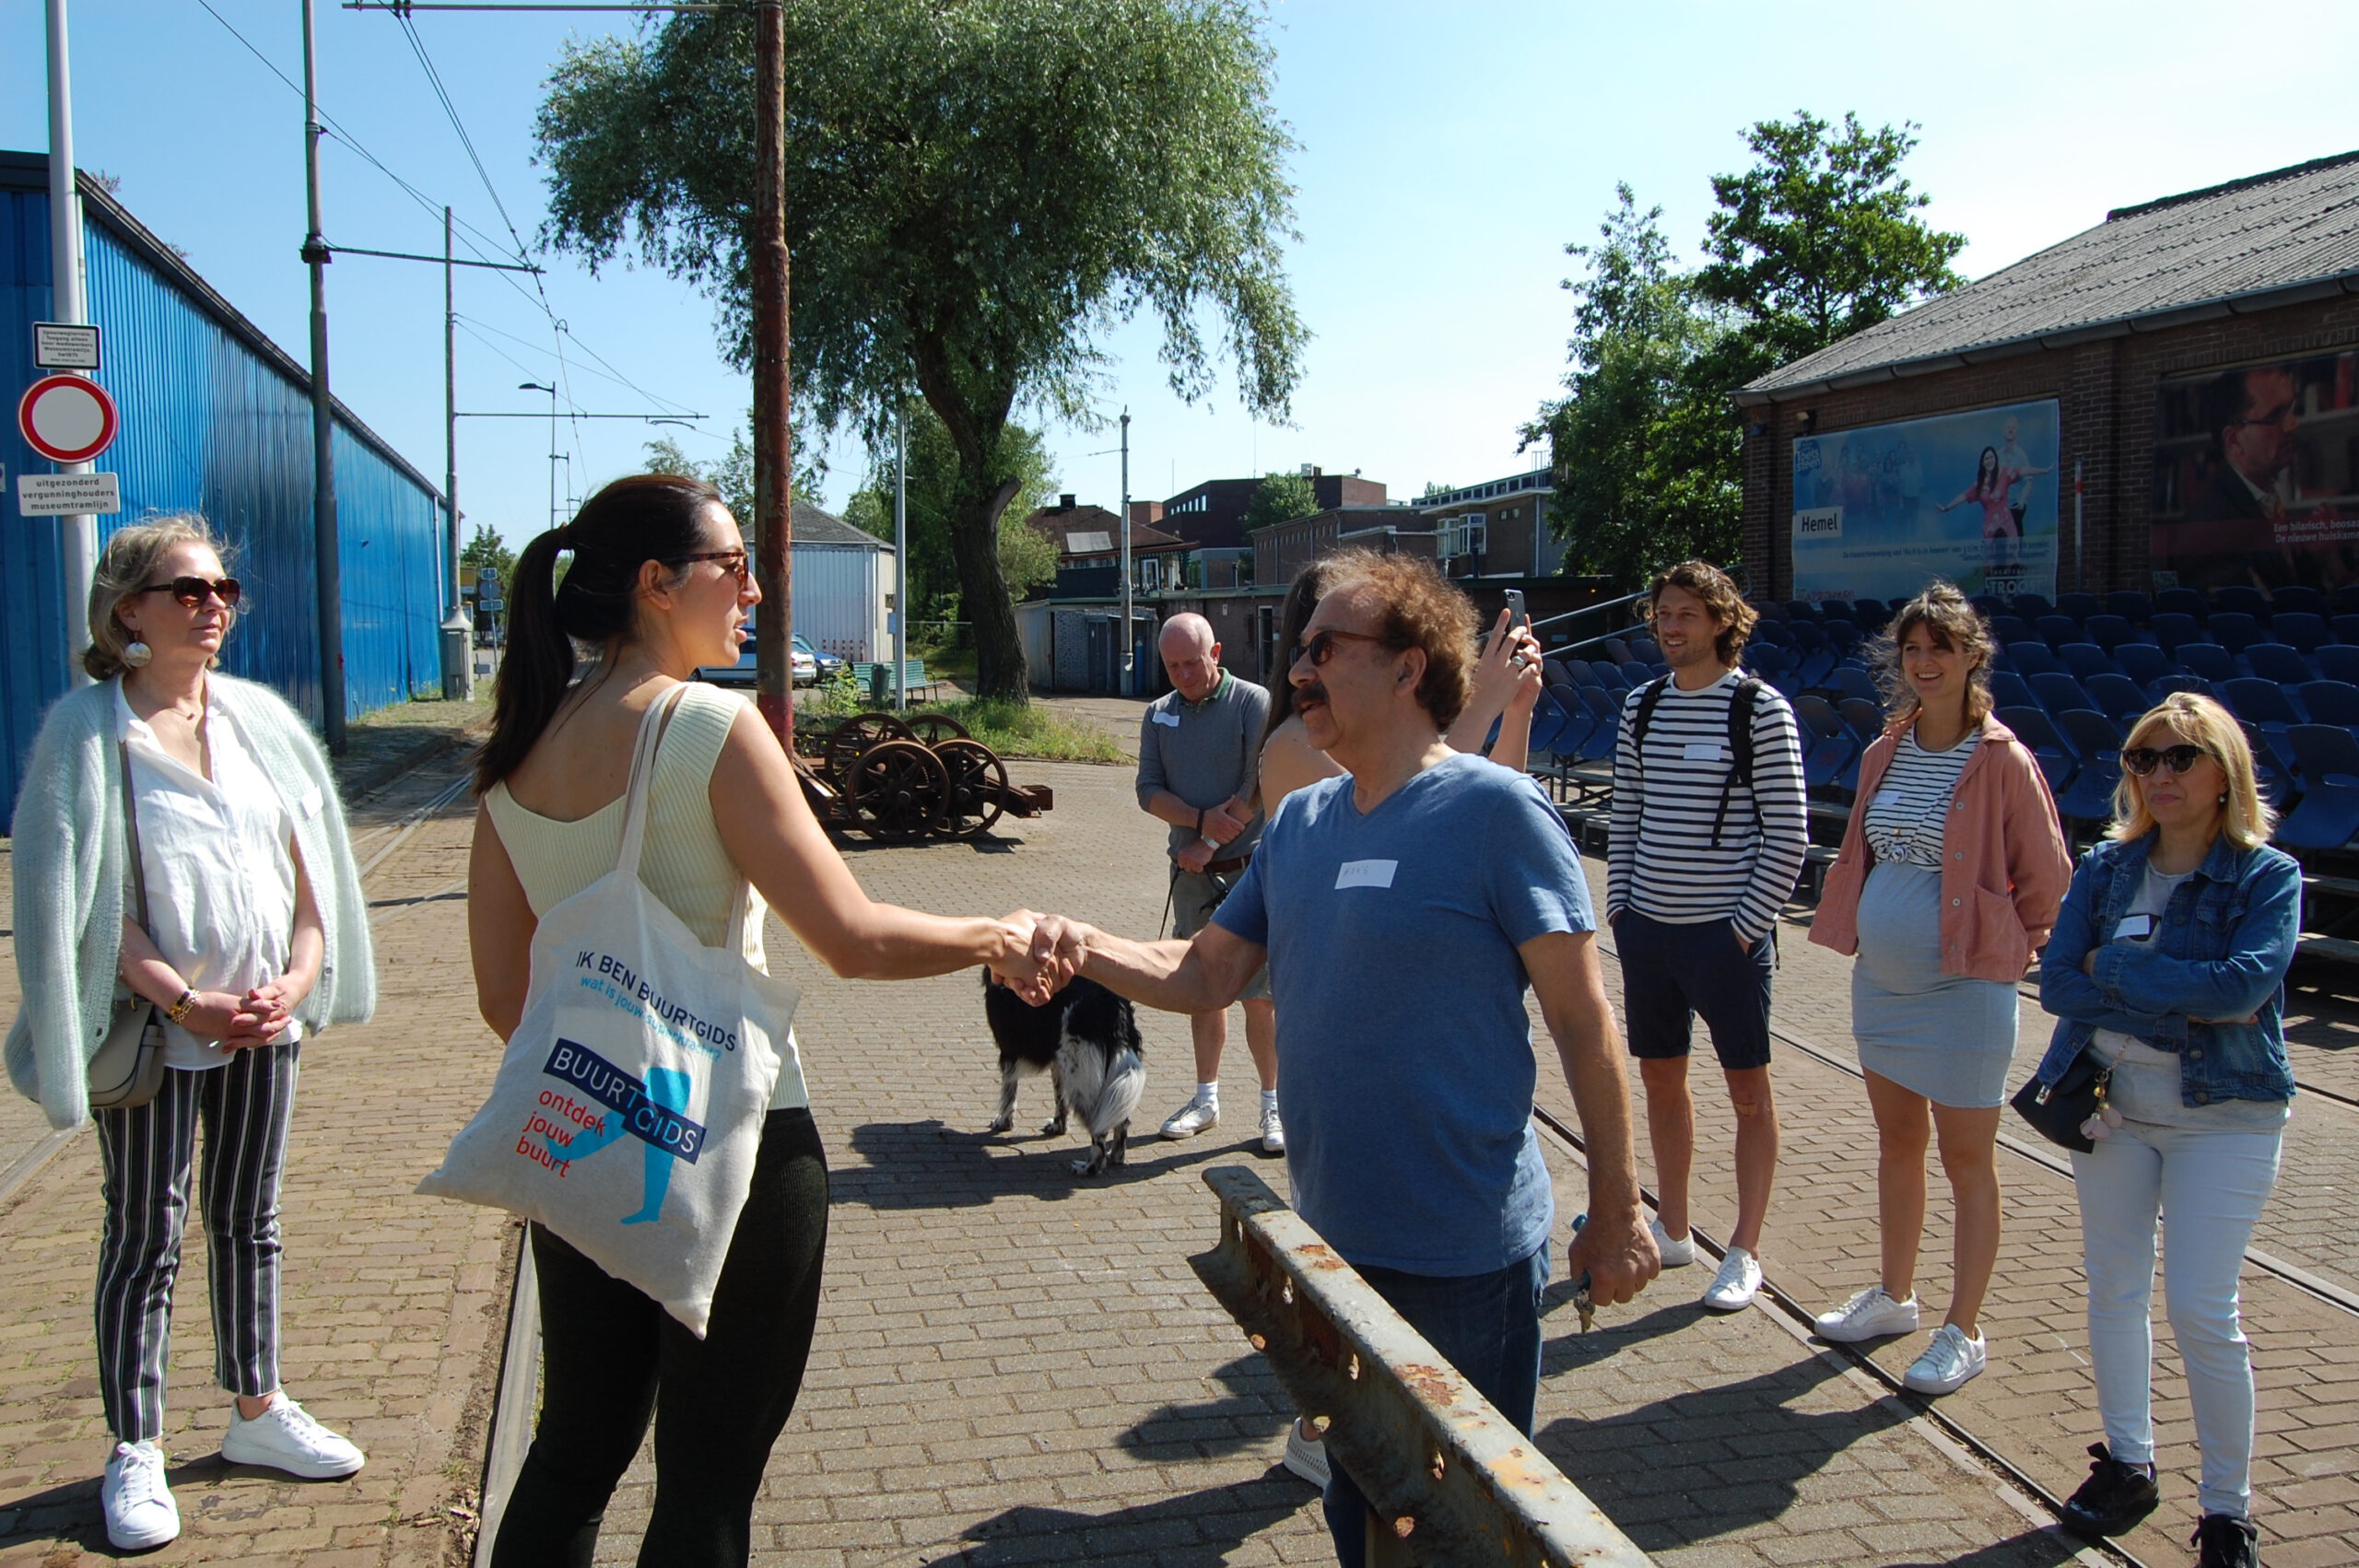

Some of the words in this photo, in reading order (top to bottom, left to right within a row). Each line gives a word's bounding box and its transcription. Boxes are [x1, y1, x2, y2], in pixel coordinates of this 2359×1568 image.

[1796, 449, 1820, 462] Toets
[1796, 458, 1822, 472] steen
[36, 478, 100, 488] uitgezonderd
[22, 489, 115, 500] vergunninghouders
[30, 500, 109, 510] museumtramlijn
[1802, 512, 1838, 532] Hemel
[2273, 522, 2288, 532] Een
[2290, 520, 2328, 532] hilarisch,
[2275, 533, 2286, 544] De
[2287, 532, 2317, 543] nieuwe
[1989, 579, 2043, 595] TROOST
[576, 951, 595, 969] IK
[598, 954, 637, 990] BEN
[637, 981, 736, 1052] BUURTGIDS
[581, 977, 604, 991] wat
[605, 983, 615, 999] is
[615, 994, 643, 1019] jouw
[645, 1014, 722, 1062] superkracht?
[553, 1047, 697, 1153] BUURTGIDS
[539, 1090, 607, 1138] ontdek
[522, 1111, 575, 1148] jouw
[516, 1136, 571, 1178] buurt
